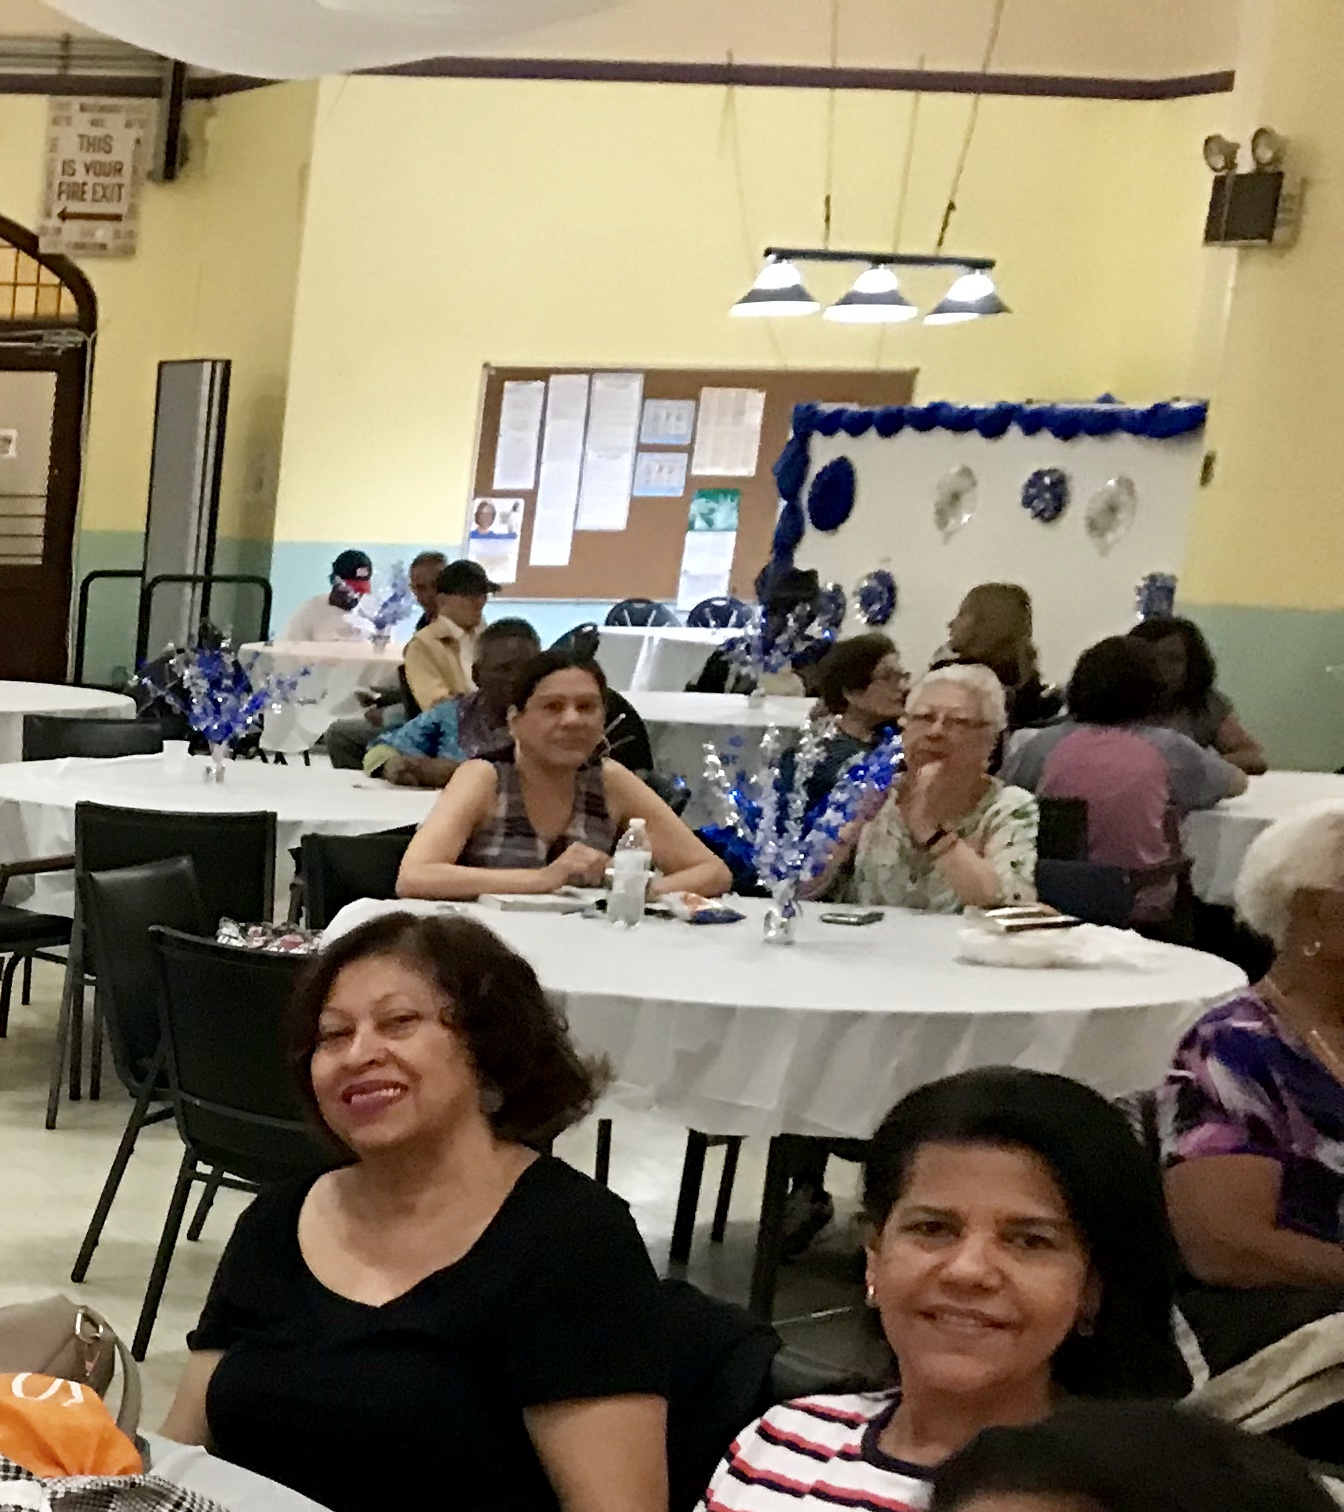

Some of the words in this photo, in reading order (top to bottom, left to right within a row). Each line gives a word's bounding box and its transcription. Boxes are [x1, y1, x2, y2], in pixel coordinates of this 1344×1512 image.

[78, 134, 113, 154] THIS
[61, 159, 76, 177] IS
[84, 160, 124, 178] YOUR
[57, 181, 88, 202] FIRE
[92, 182, 124, 203] EXIT
